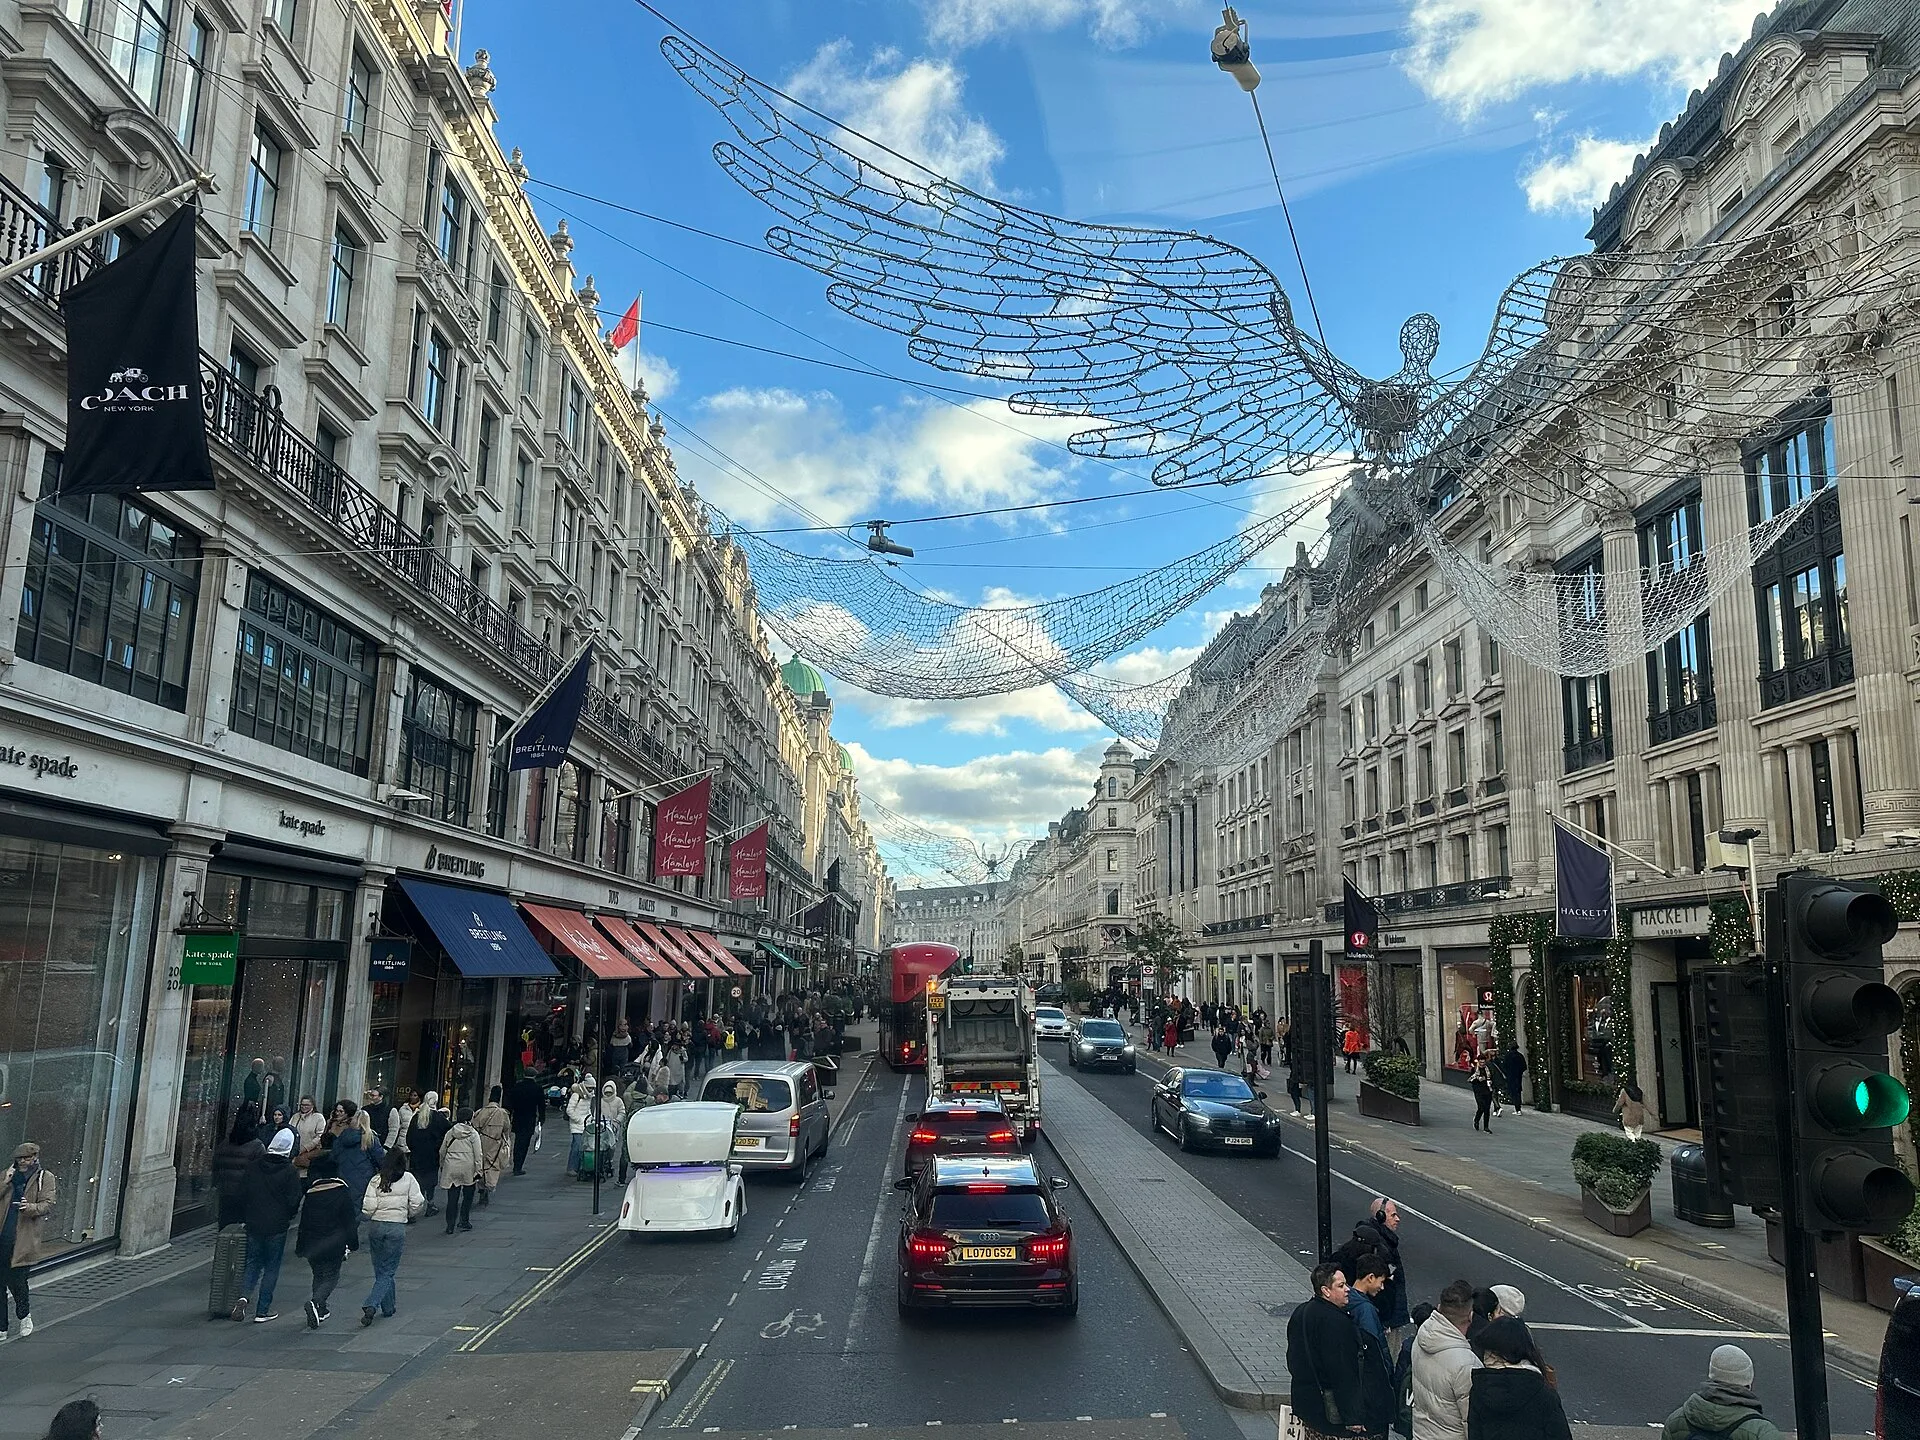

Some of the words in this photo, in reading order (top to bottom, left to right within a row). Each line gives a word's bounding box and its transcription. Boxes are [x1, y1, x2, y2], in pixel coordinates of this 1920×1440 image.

[80, 385, 190, 410] COACH
[515, 744, 565, 754] BREITLING
[29, 756, 79, 778] spade
[279, 809, 300, 829] kate
[300, 819, 326, 838] spade
[663, 805, 703, 826] Hamleys
[662, 828, 702, 849] Hamleys
[735, 847, 763, 860] Hamleys
[437, 852, 485, 879] BREITLING
[661, 852, 700, 873] Hamleys
[735, 864, 762, 878] Hamleys
[734, 881, 762, 895] Hamleys
[1560, 907, 1608, 917] HACKETT
[1640, 907, 1699, 926] HACKETT
[468, 928, 508, 941] BREITLING
[185, 949, 206, 958] kate
[207, 950, 235, 960] spade
[732, 989, 742, 997] 20
[967, 1248, 992, 1258] LO70
[994, 1247, 1013, 1258] GSZ
[756, 1259, 797, 1290] LOADING
